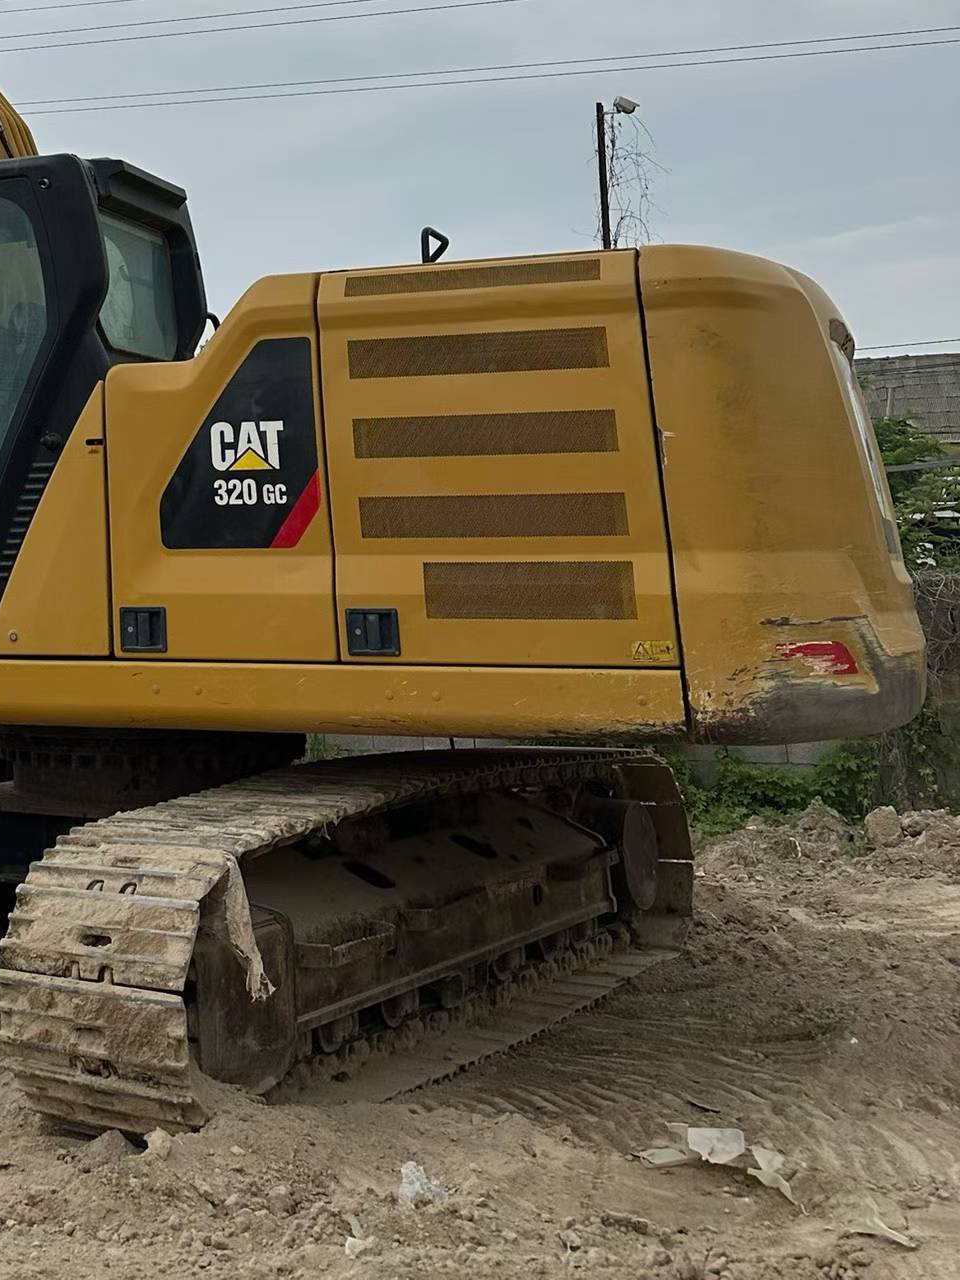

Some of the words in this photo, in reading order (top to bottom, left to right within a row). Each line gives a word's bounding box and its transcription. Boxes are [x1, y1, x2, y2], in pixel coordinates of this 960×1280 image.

[210, 420, 284, 471] CAT
[213, 478, 258, 506] 320
[262, 483, 288, 505] GC
